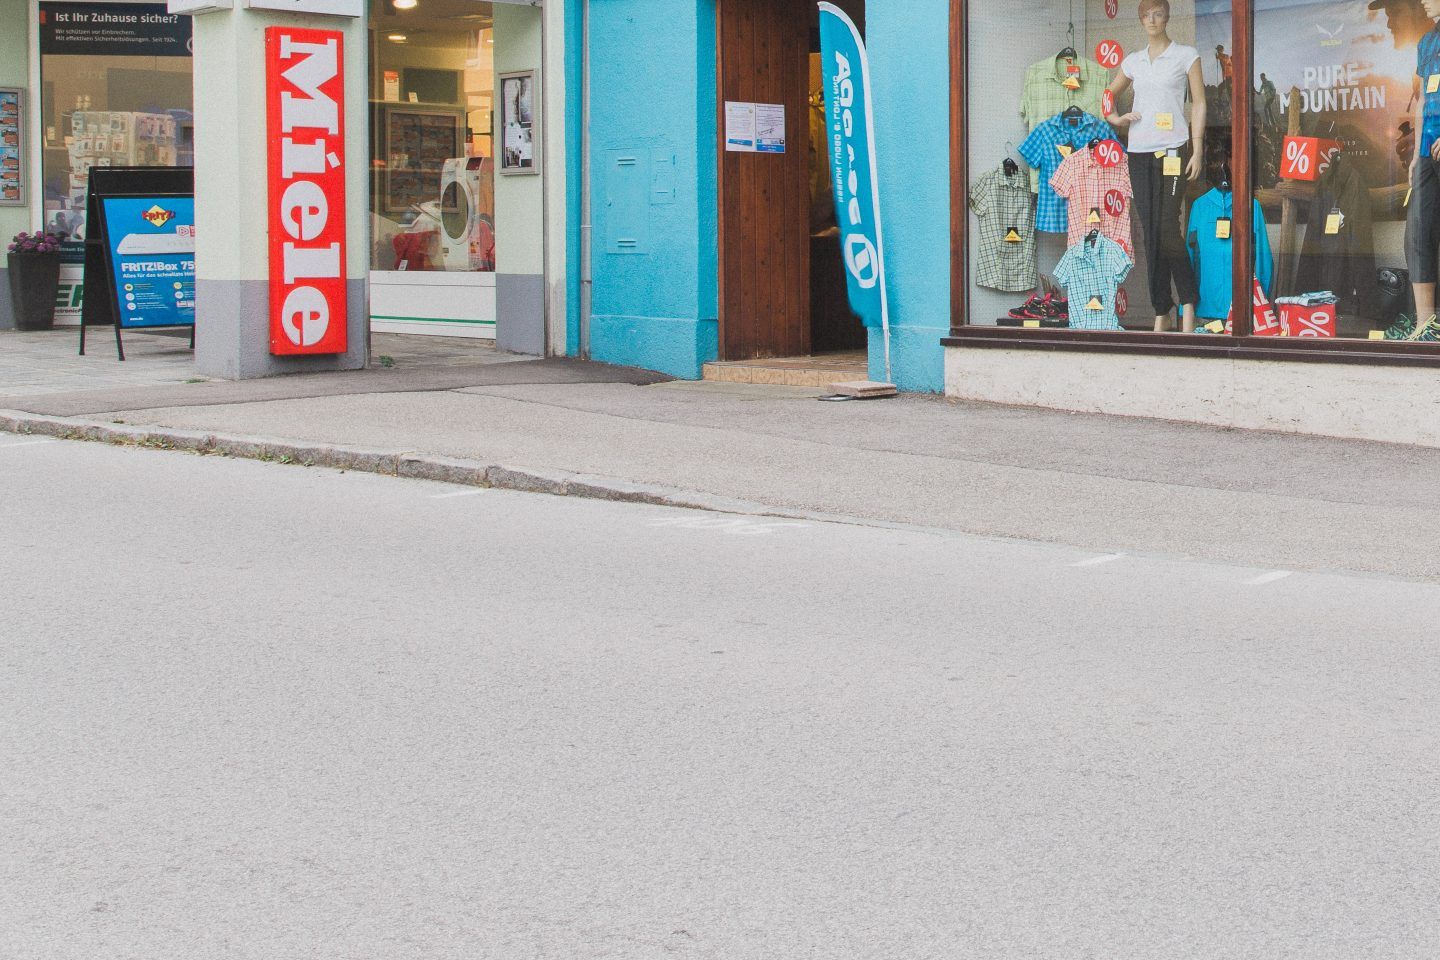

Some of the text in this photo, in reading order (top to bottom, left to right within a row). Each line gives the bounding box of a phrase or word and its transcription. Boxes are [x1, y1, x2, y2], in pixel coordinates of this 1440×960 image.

[55, 13, 179, 24] Ist Ihr Zuhause sicher?
[1304, 63, 1359, 89] PURE
[280, 34, 340, 347] Miele
[121, 261, 178, 272] FRITZ!Box
